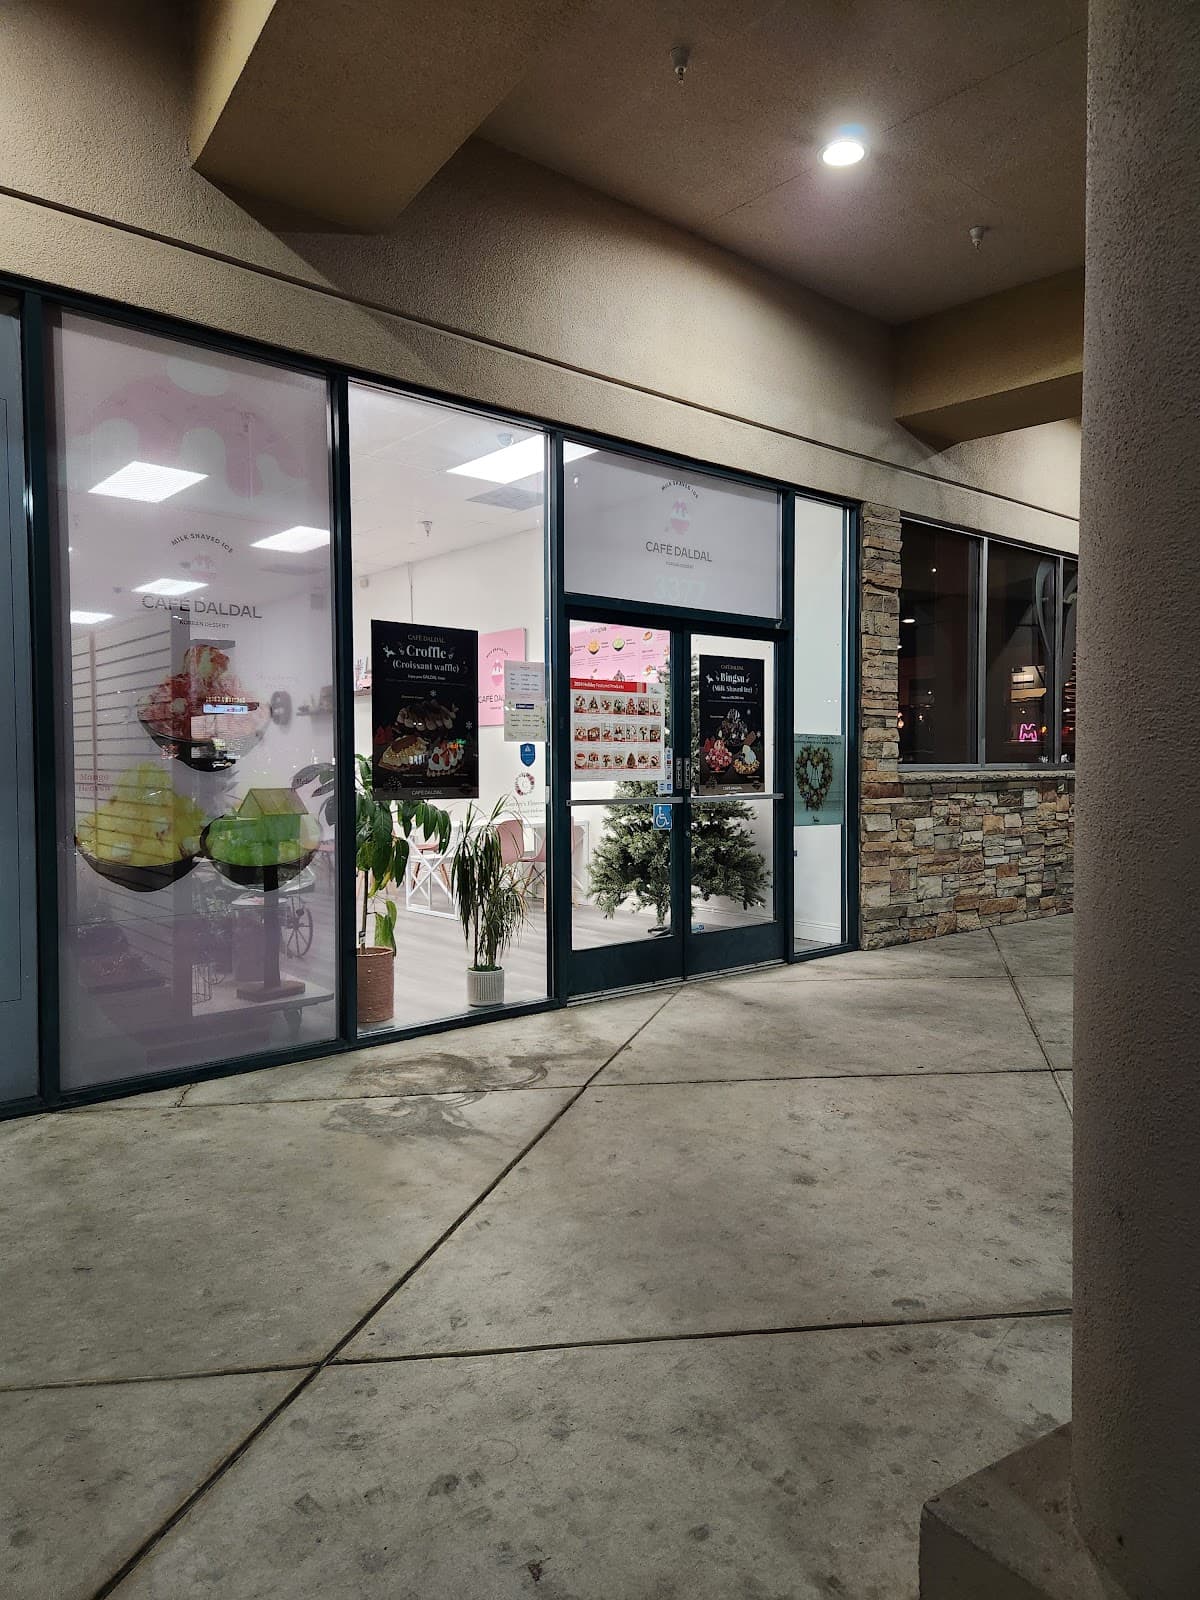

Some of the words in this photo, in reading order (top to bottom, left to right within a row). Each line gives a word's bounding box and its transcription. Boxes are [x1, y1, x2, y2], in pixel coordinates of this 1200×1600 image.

[170, 535, 189, 547] MILK
[190, 533, 220, 544] SHAVED
[221, 542, 234, 553] ICE
[674, 546, 712, 562] DALDAL
[194, 600, 263, 618] DALDAL
[406, 644, 447, 659] Croffle
[392, 659, 433, 671] (Croissant
[434, 663, 460, 673] waffle)
[720, 672, 745, 684] Bingsu
[712, 684, 726, 692] (Milk
[726, 684, 743, 693] Shaved
